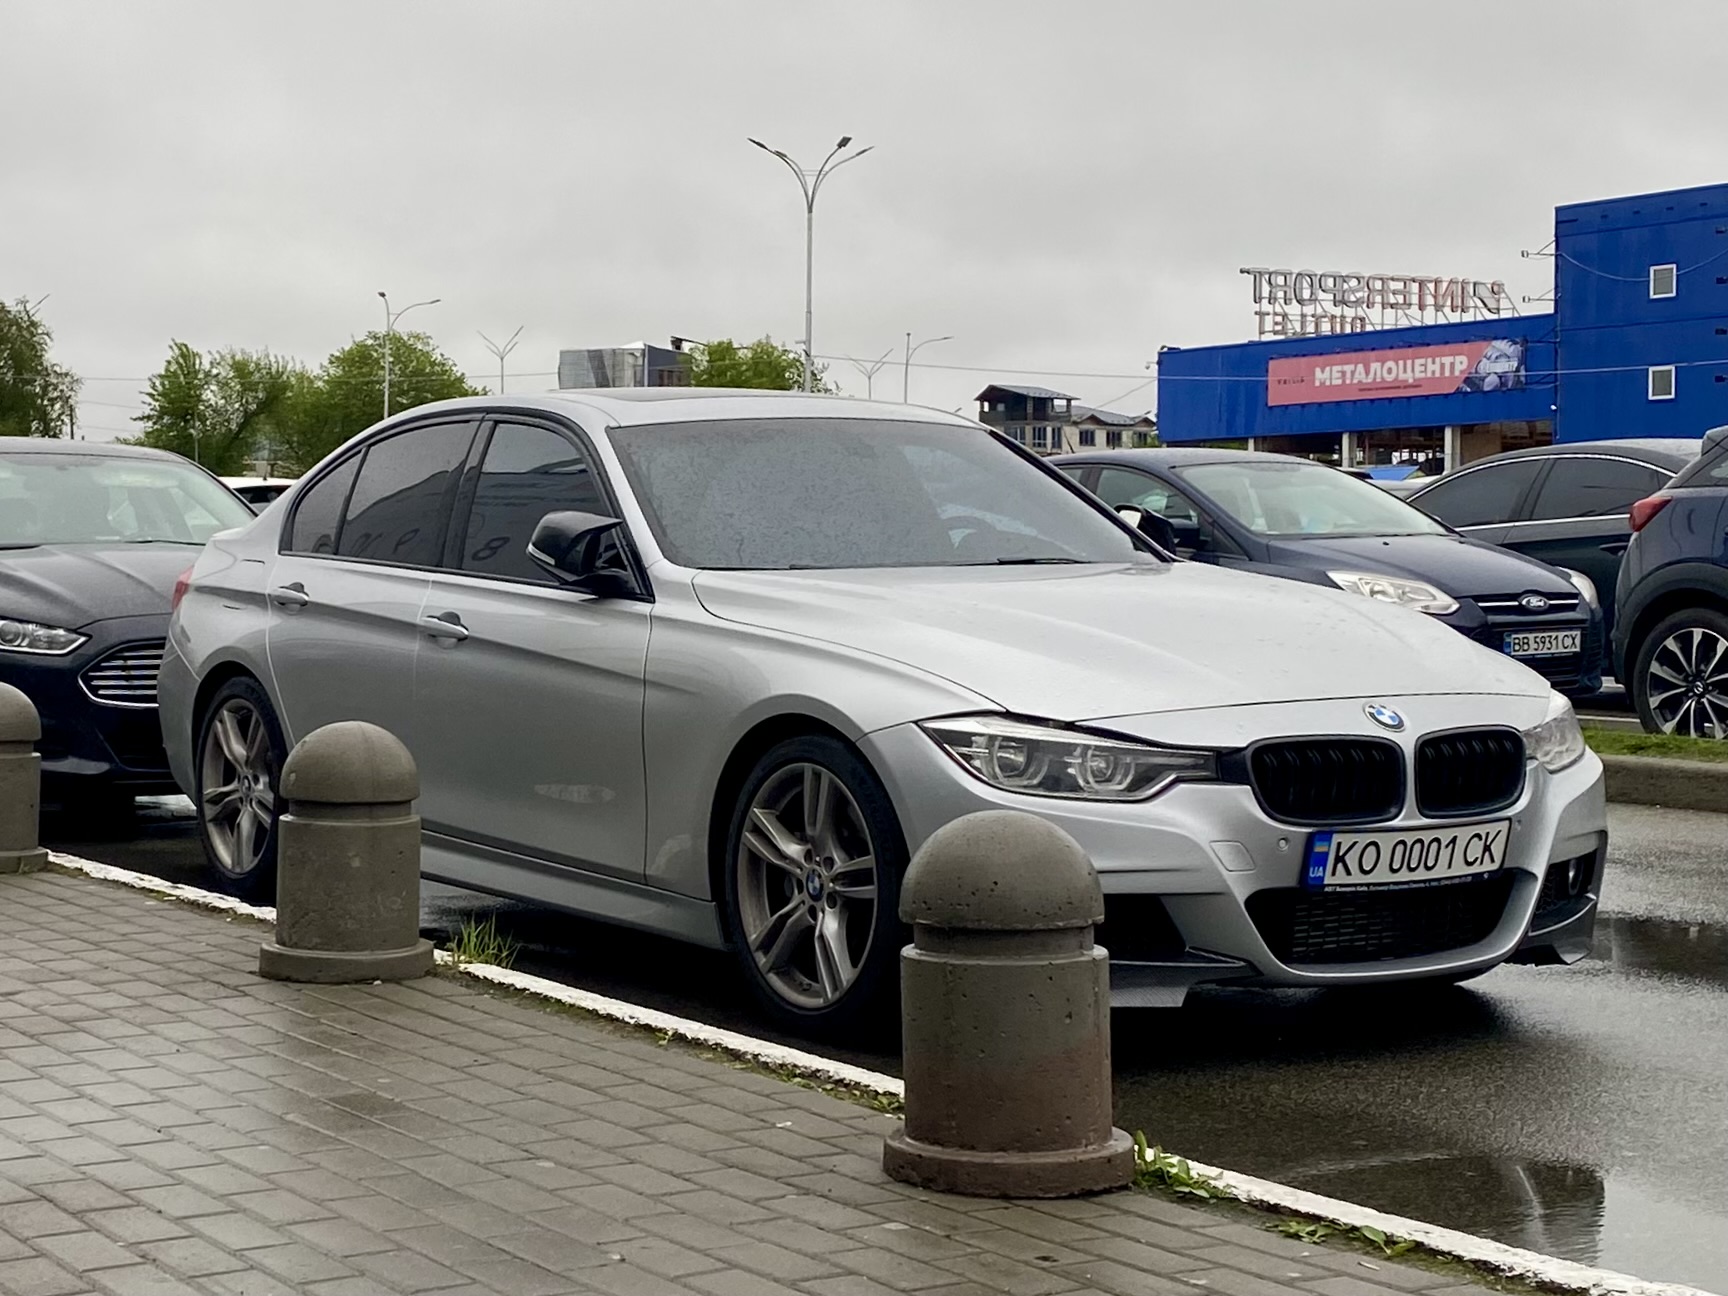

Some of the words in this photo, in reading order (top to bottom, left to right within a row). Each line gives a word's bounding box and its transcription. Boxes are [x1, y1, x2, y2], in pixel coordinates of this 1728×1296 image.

[1314, 355, 1468, 386] МЕТАЛОЦЕНТР
[1512, 636, 1530, 652] BB
[1533, 635, 1559, 651] 5931
[1561, 633, 1578, 649] CX
[1331, 840, 1381, 877] KO
[1389, 835, 1458, 874] 0001
[1463, 829, 1502, 867] CK
[1309, 867, 1324, 878] UA
